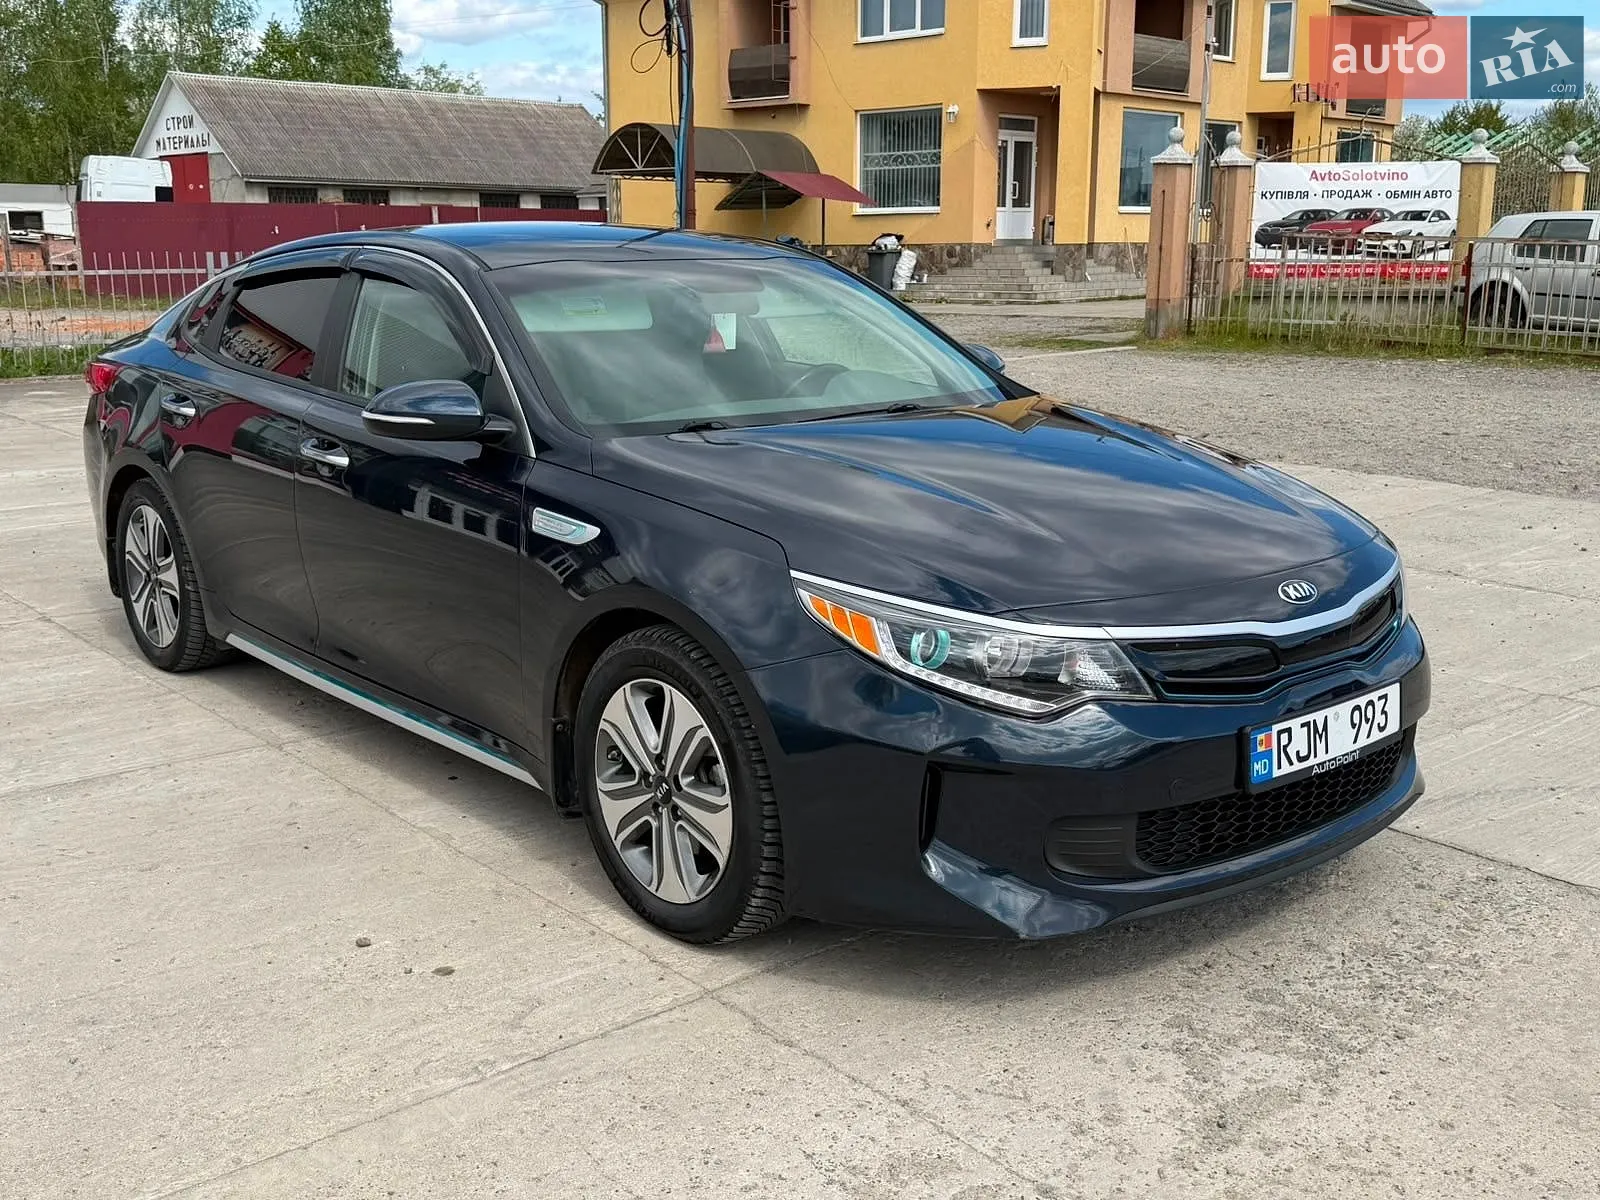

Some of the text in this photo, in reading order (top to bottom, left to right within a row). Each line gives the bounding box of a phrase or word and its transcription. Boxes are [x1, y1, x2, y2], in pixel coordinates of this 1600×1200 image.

[156, 132, 211, 151] МАТЕРИАЛЫ
[1309, 169, 1409, 182] AvtoSolotvino
[1260, 189, 1453, 200] КУПІВЛЯ ПРОДАЖ ОБМІН АВТО
[1283, 582, 1315, 600] KIA
[1253, 693, 1389, 777] MD RJM 993
